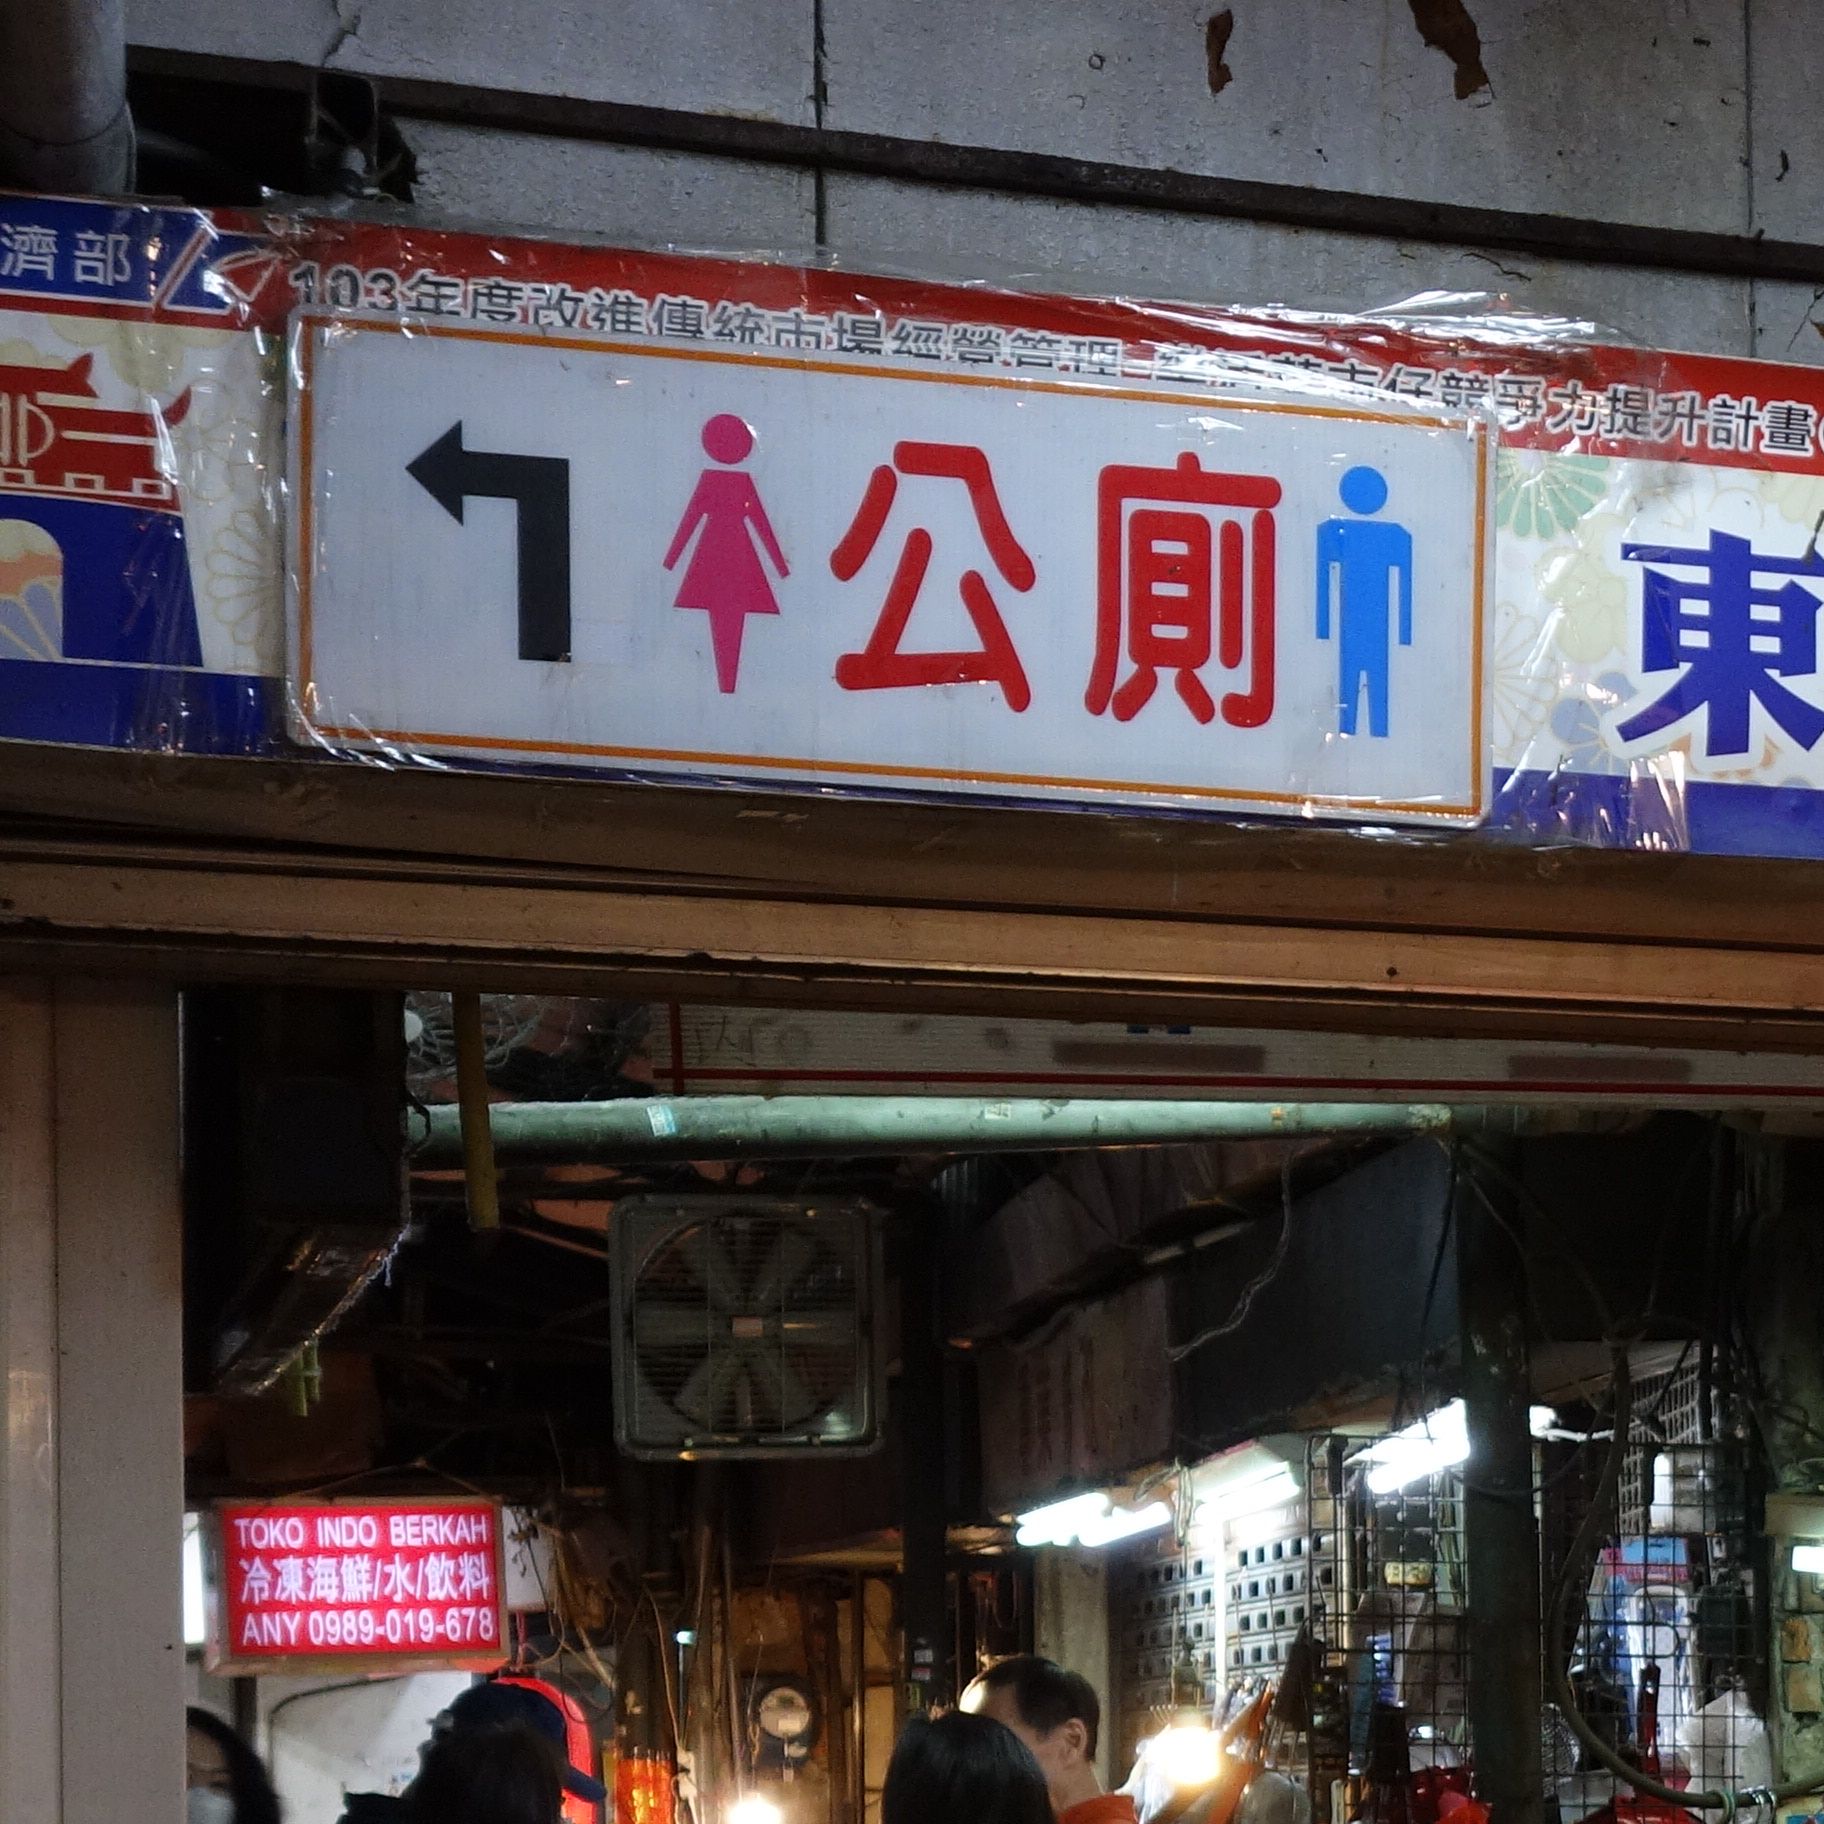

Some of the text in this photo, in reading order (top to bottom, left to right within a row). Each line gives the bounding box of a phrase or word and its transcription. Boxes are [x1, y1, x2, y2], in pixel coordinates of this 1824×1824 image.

[831, 440, 1282, 728] 公廁
[235, 1514, 488, 1549] TOKO INDO BERKAH
[239, 1552, 490, 1605] 冷凍海鮮/水/飲料
[242, 1606, 494, 1647] ANY 0989-019-678
